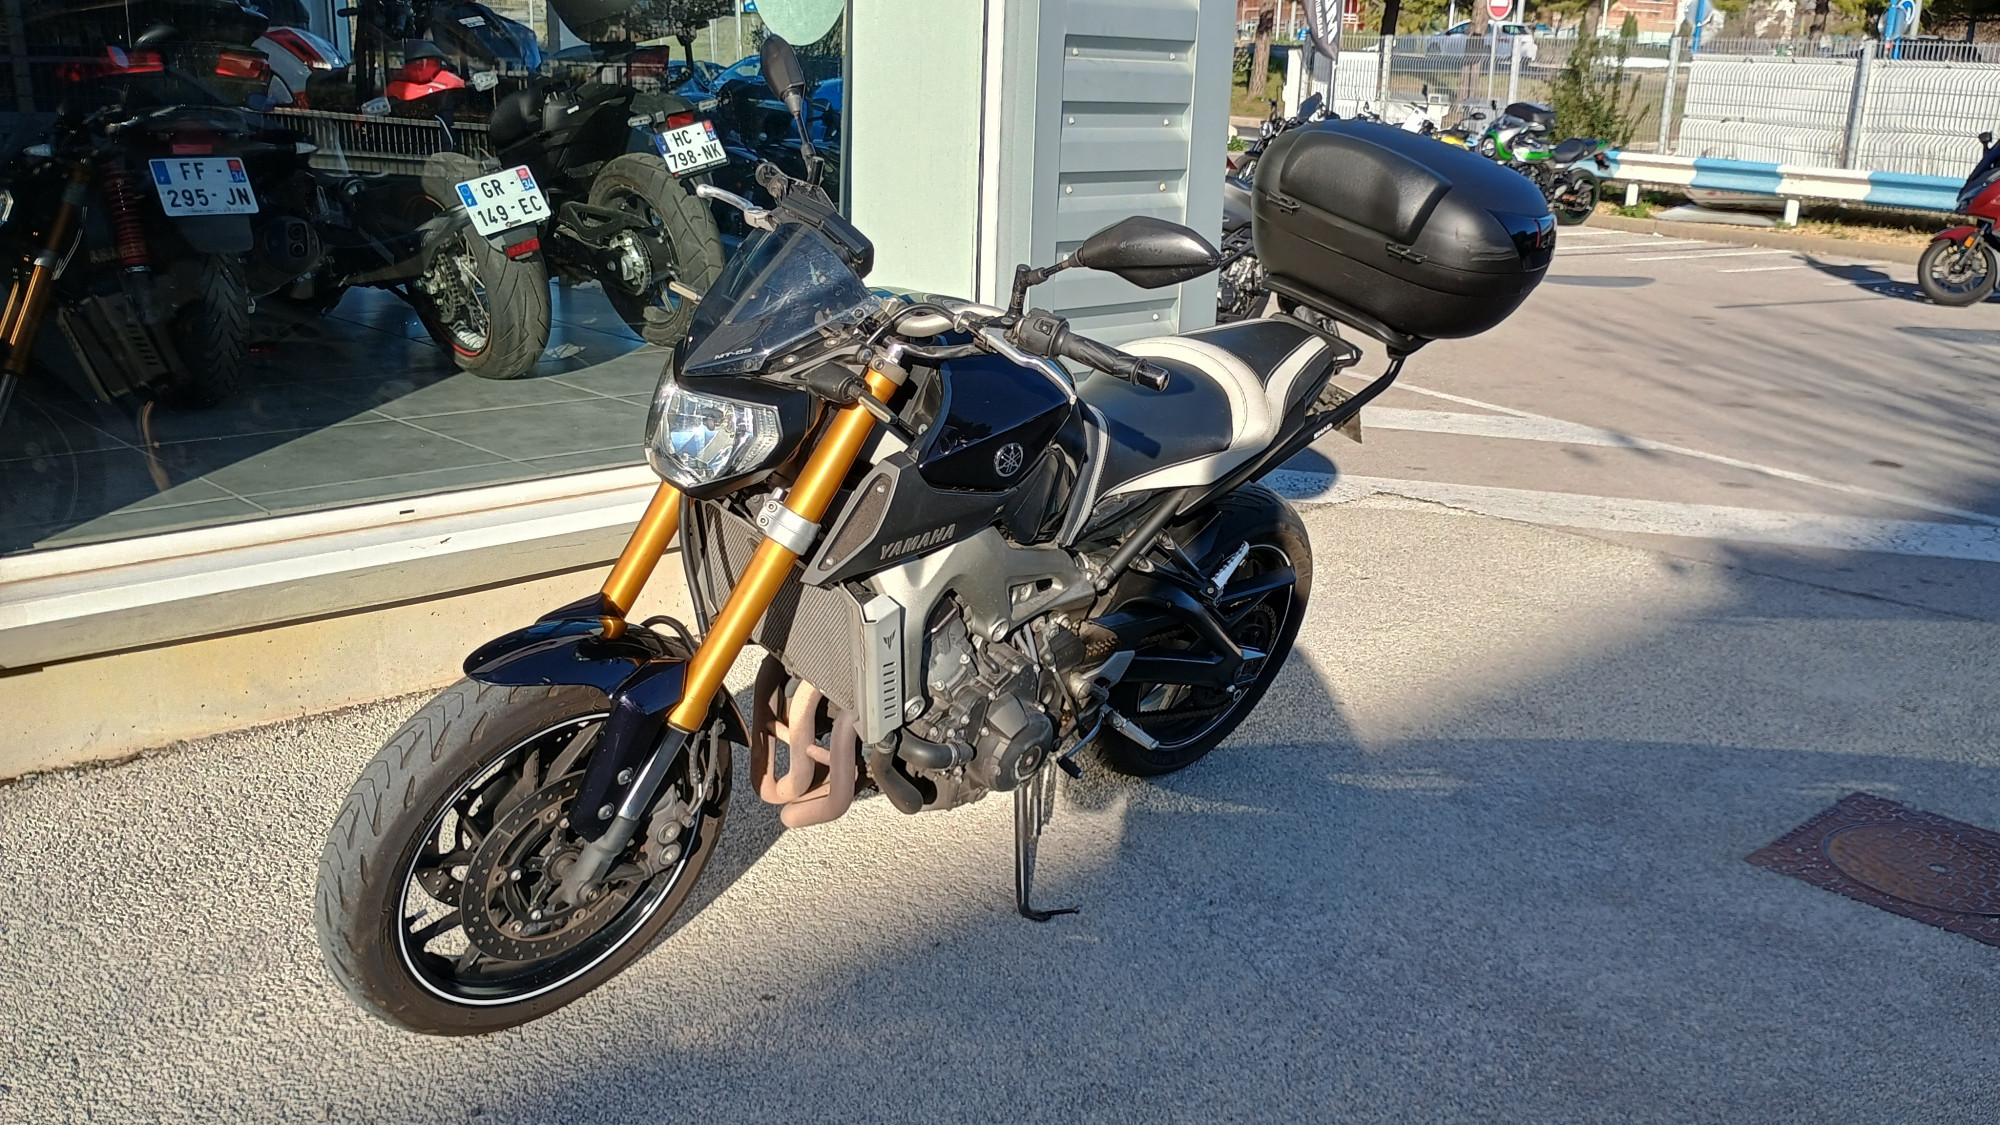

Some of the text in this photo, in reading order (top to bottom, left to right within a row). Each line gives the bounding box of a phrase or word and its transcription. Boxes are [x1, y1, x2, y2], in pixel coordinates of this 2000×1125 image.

[672, 129, 692, 147] HC
[668, 142, 722, 169] 798-NK
[179, 162, 205, 181] FF
[231, 171, 246, 182] 34
[480, 179, 505, 199] GR
[521, 179, 534, 190] 34
[477, 195, 542, 227] 149-EC
[880, 523, 956, 561] YAMAHA
